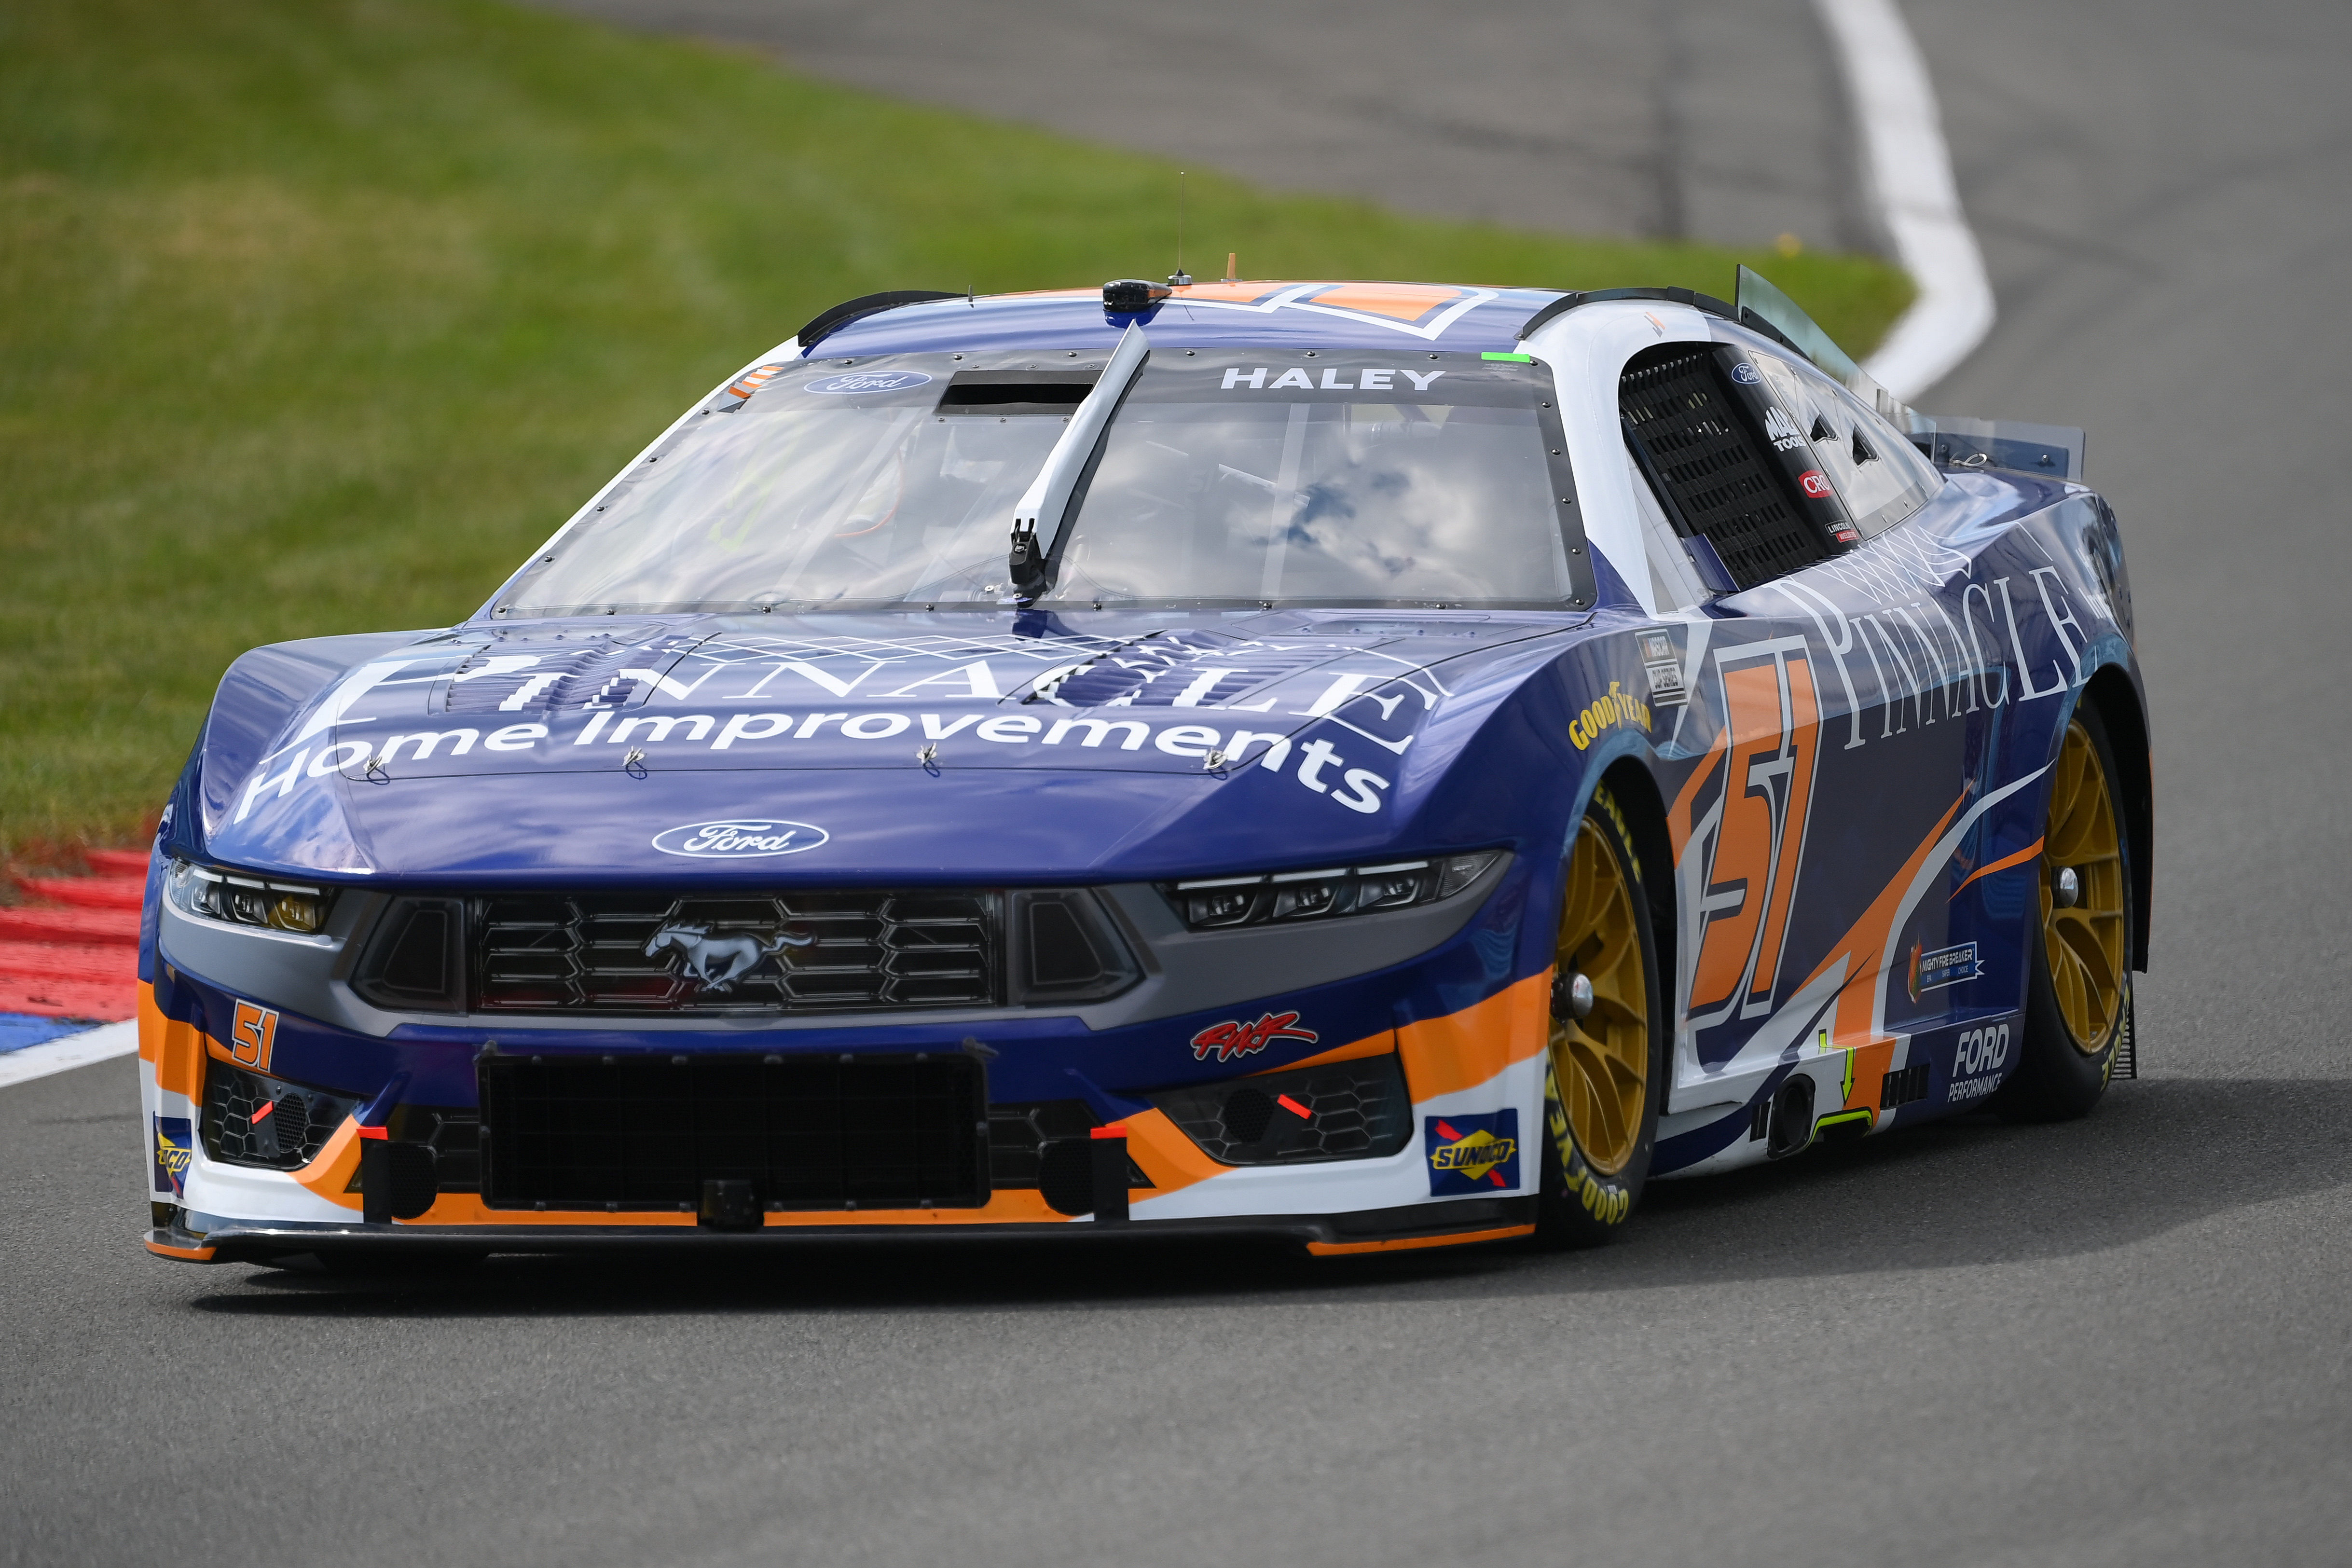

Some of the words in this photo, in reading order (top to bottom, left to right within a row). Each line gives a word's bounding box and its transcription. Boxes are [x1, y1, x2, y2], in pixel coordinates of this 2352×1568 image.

[1220, 368, 1446, 391] HALEY
[1773, 436, 1806, 453] TOOLS
[1803, 474, 1830, 494] CRC
[1761, 565, 2099, 750] PINNACLE
[259, 654, 1441, 765] PINNACLE
[1568, 681, 1652, 751] GOODYEAR
[233, 721, 549, 825] Home
[573, 711, 1390, 814] Improvements
[683, 824, 797, 852] Ford
[1686, 634, 1824, 1021] 51
[1922, 957, 1939, 973] MIGHTY
[1939, 954, 1949, 968] FIRE
[1949, 949, 1973, 965] BREAKER
[232, 998, 279, 1073] 51
[1190, 1011, 1318, 1062] RWR
[1953, 1024, 2009, 1077] FORD
[1947, 1072, 2002, 1103] PERFORMANCE
